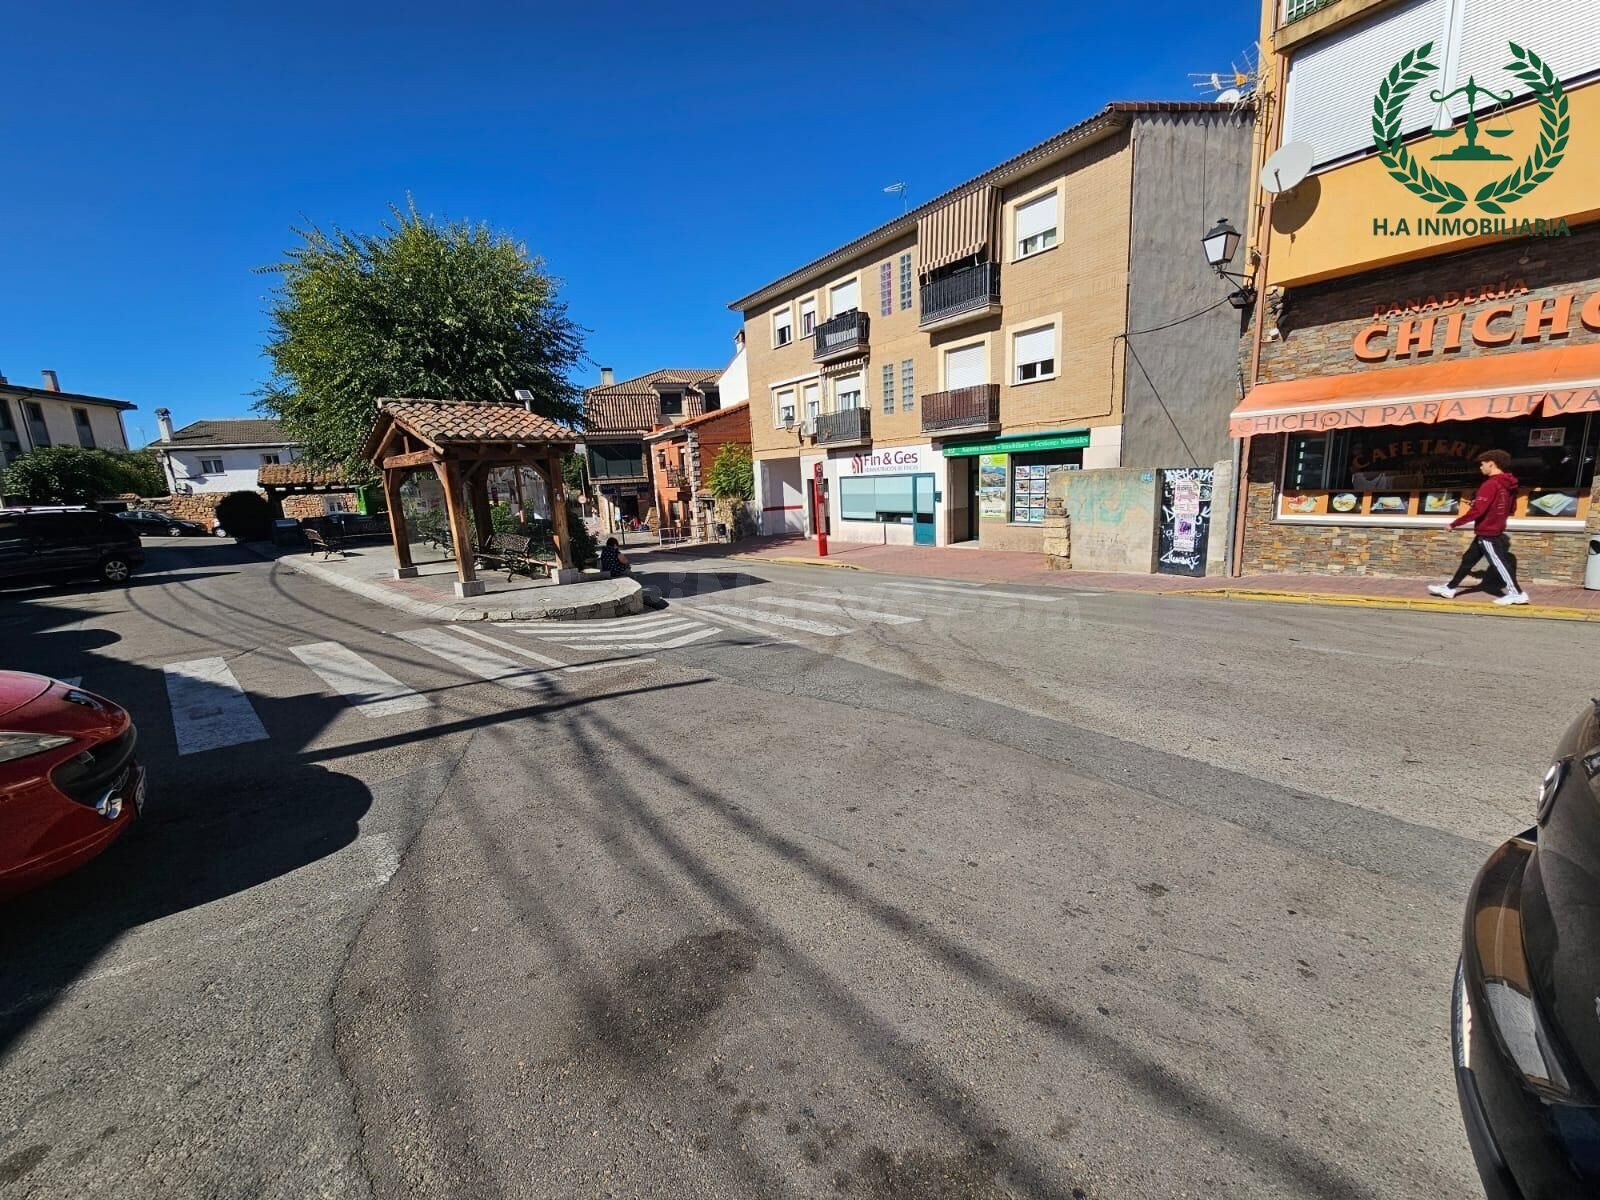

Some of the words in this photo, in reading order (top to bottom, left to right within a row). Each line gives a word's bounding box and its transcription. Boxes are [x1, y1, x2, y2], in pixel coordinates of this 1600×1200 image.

[1238, 409, 1366, 433] CHICHON
[1381, 400, 1465, 423] PARA
[864, 455, 881, 466] Fin
[882, 452, 892, 465] &
[894, 451, 918, 464] Ges
